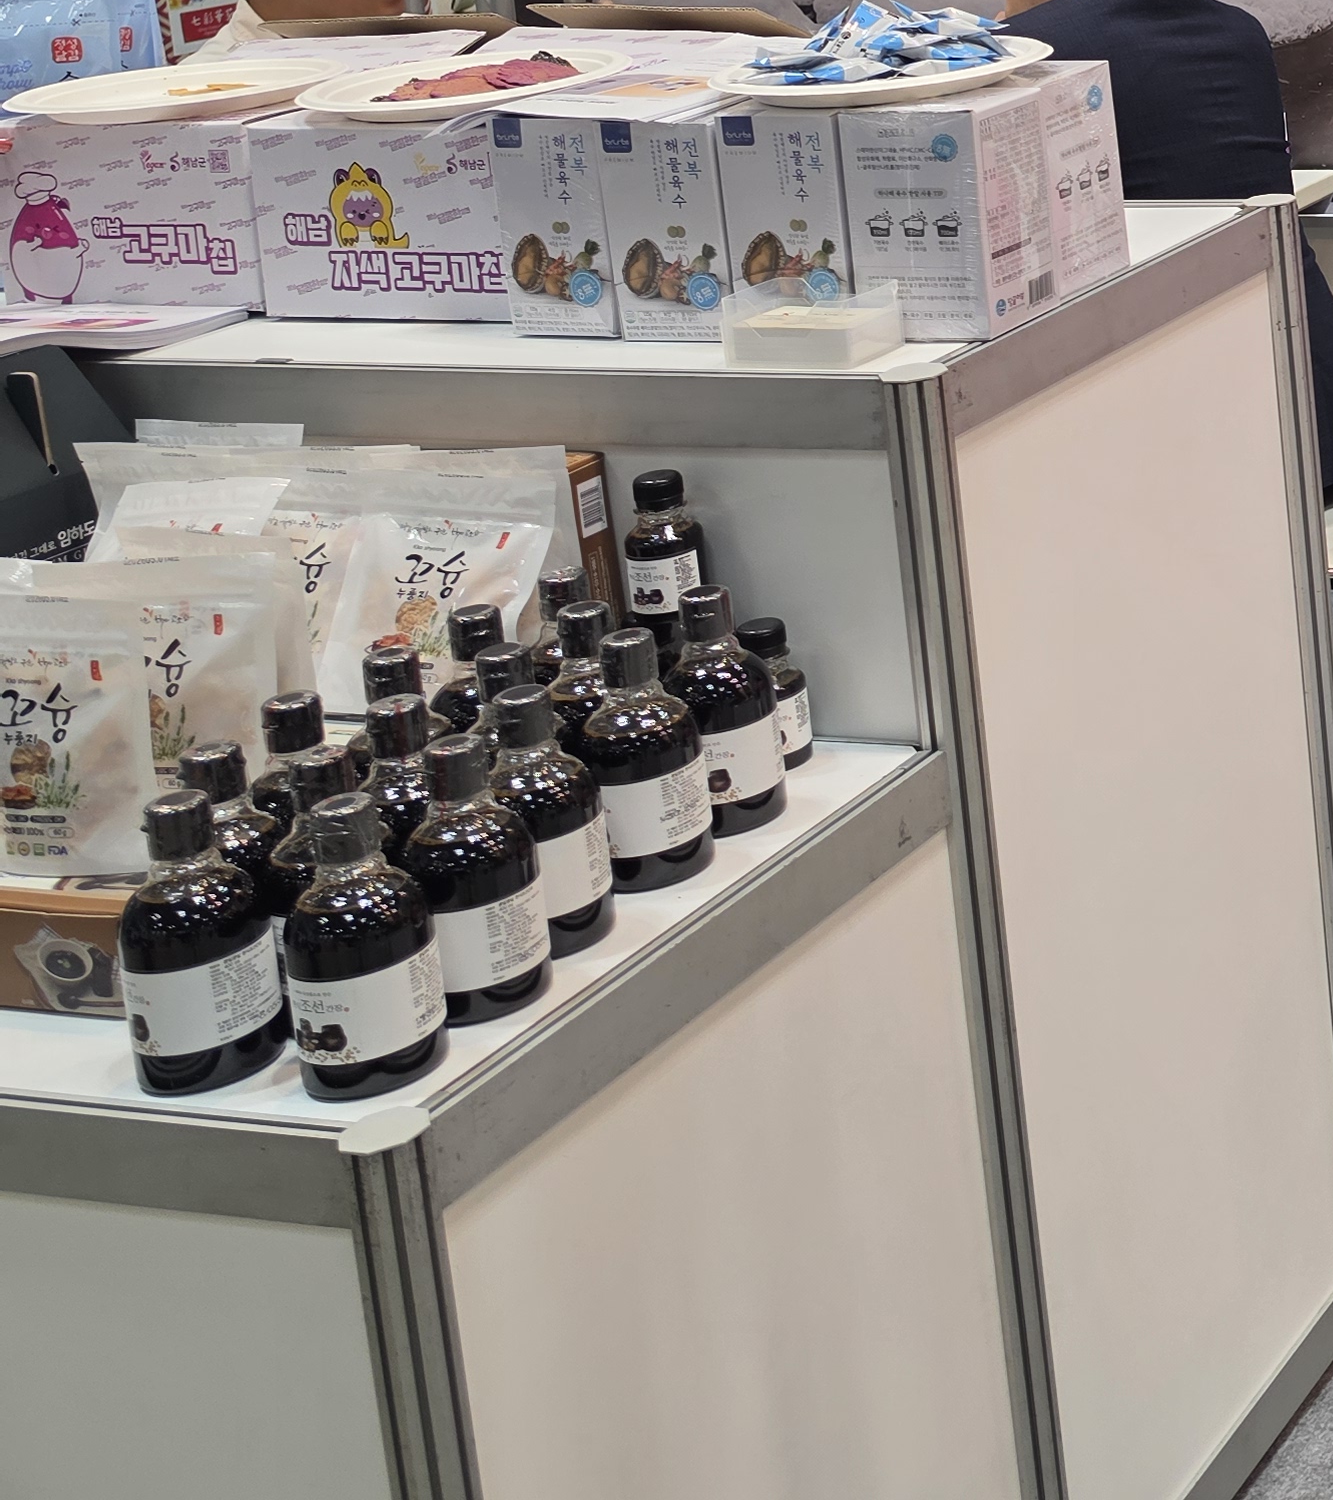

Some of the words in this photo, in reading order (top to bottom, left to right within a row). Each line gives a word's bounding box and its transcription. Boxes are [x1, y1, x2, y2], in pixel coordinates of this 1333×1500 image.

[459, 159, 486, 170] 해남군
[552, 134, 573, 205] 해물육수
[569, 134, 588, 176] 전복
[664, 138, 687, 209] 해물육수
[682, 139, 702, 180] 전복
[788, 131, 809, 203] 해물육수
[805, 131, 824, 174] 전복
[91, 217, 122, 239] 해남
[122, 223, 238, 274] 고구마칩
[284, 213, 332, 246] 해남
[329, 251, 391, 291] 자색
